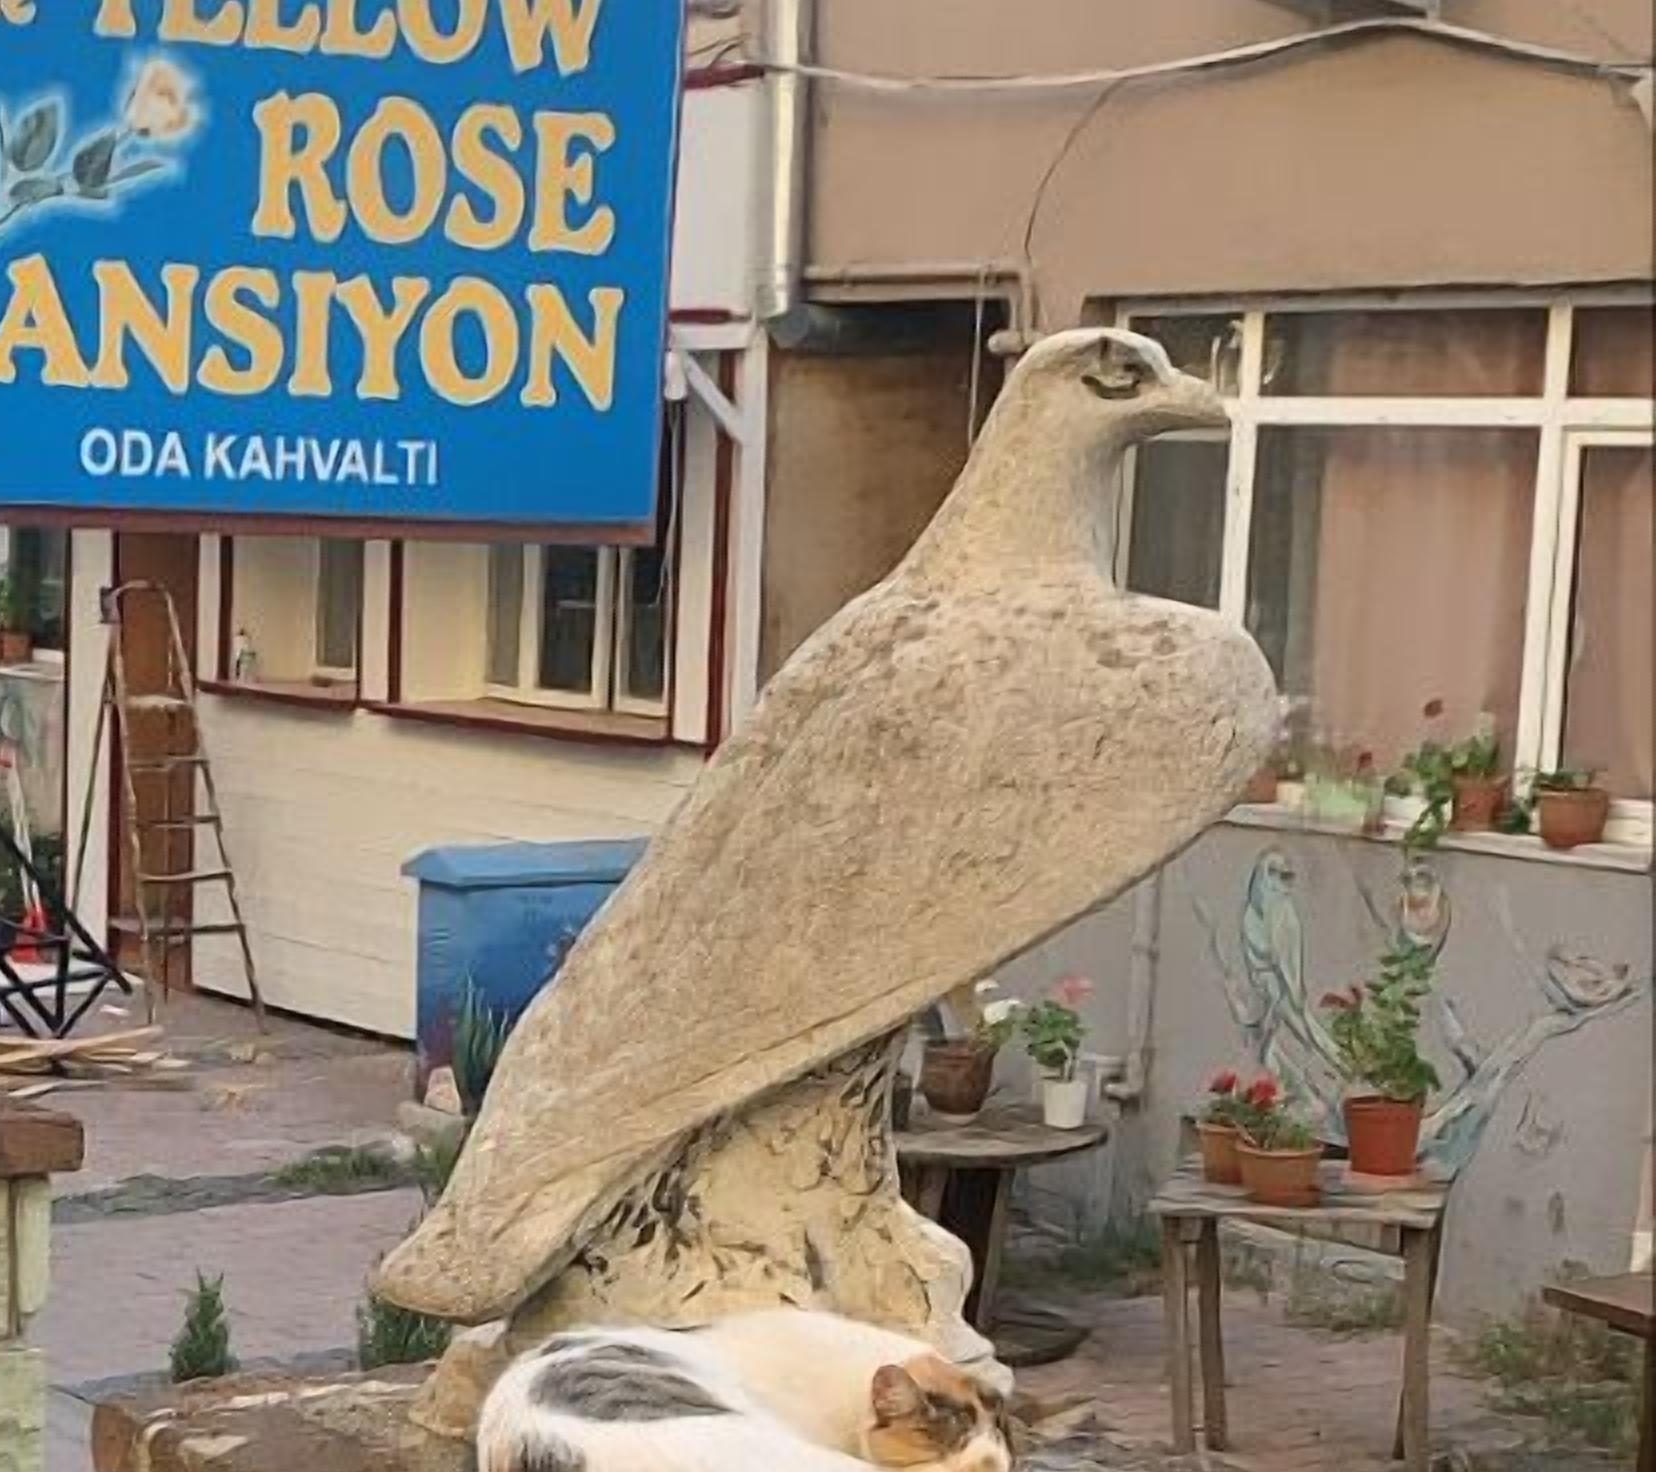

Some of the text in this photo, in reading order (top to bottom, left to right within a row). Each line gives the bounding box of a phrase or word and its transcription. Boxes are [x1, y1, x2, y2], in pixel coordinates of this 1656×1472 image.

[252, 90, 615, 256] ROSE
[80, 427, 439, 487] ODA KAHVALTI
